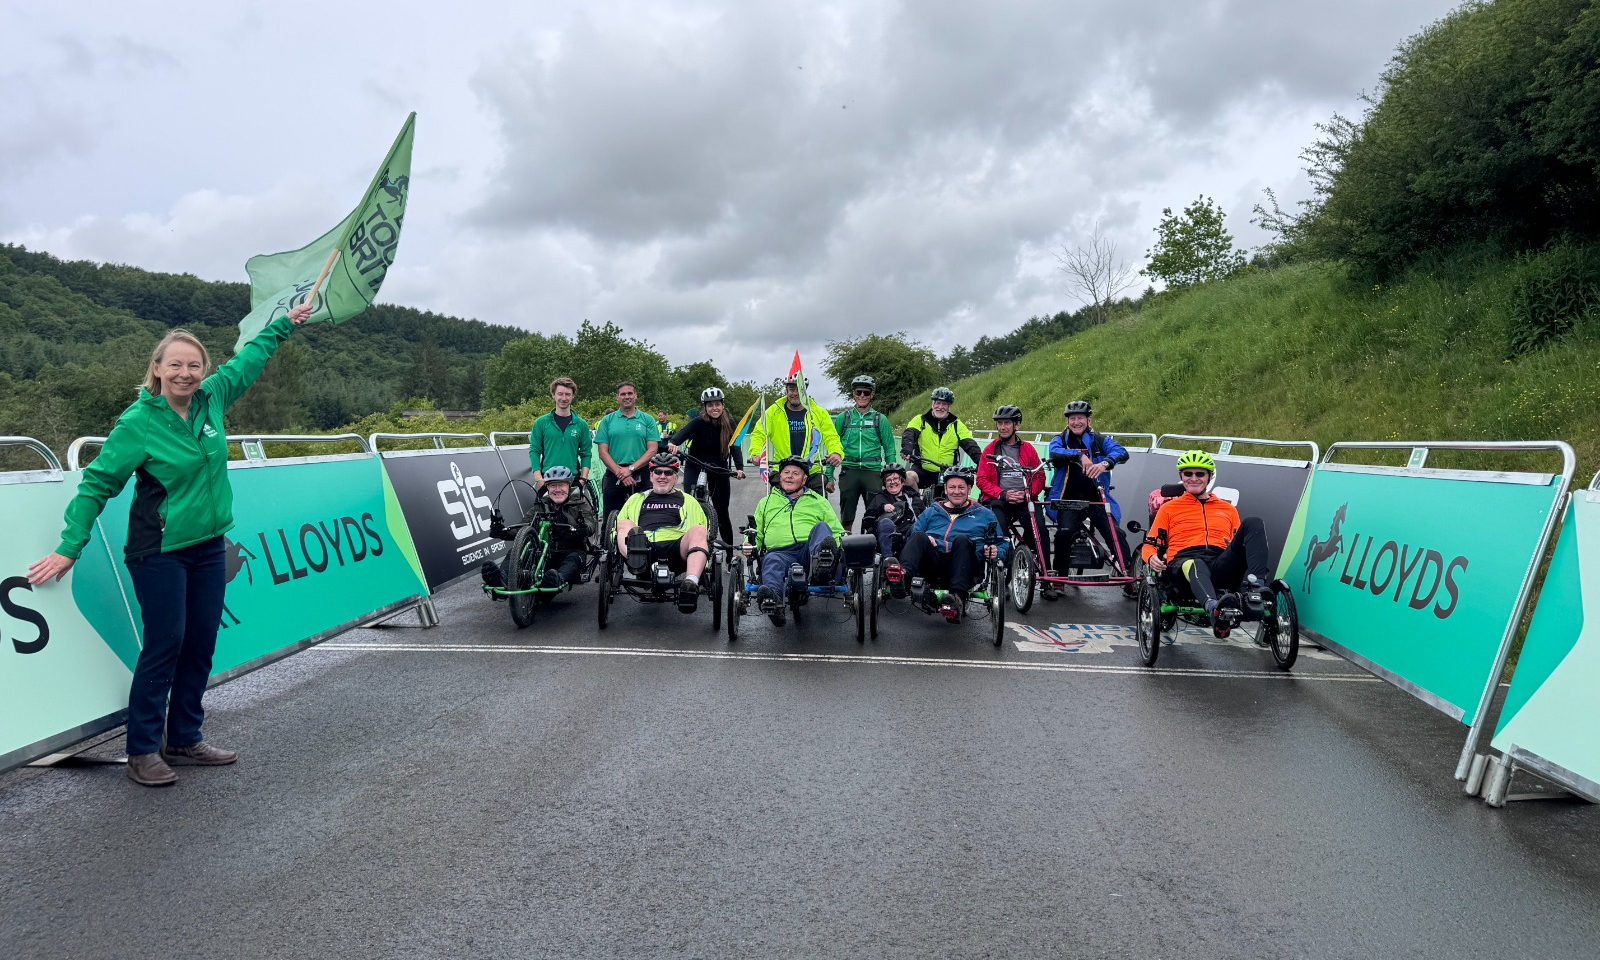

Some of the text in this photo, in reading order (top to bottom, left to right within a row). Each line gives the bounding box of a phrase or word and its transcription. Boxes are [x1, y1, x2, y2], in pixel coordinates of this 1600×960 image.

[349, 221, 389, 294] BRIT
[257, 511, 384, 586] LLOYDS
[461, 540, 507, 565] SCIENCE IN SPORT
[1339, 532, 1470, 620] LLOYDS
[0, 575, 50, 654] S
